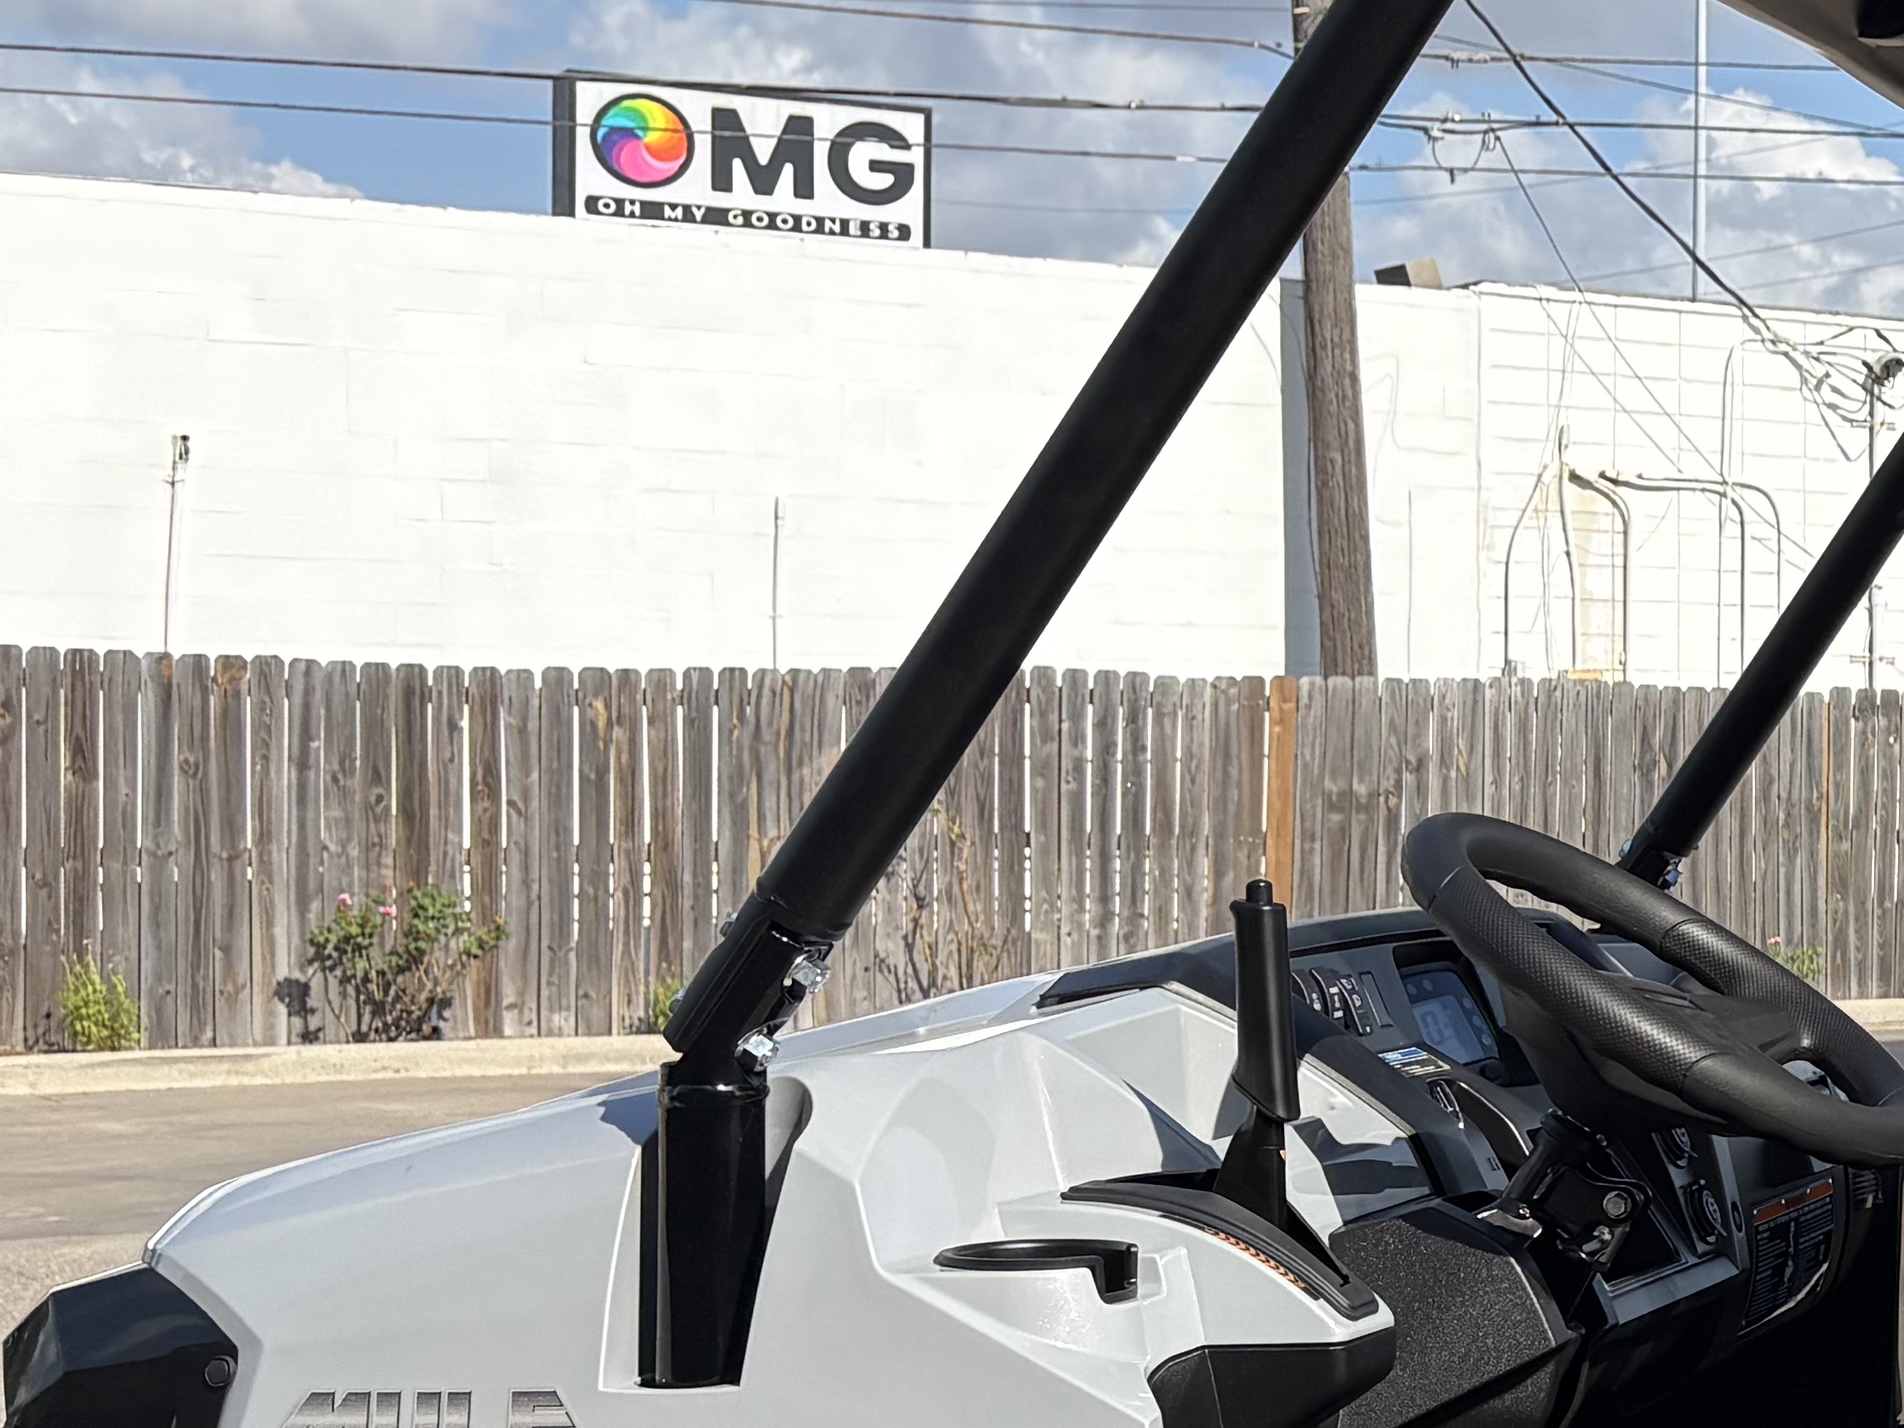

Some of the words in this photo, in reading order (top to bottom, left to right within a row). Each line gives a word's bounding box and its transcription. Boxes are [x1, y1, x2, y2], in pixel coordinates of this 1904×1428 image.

[597, 197, 641, 217] OH
[664, 204, 706, 222] MY
[727, 209, 900, 239] GOODNESS
